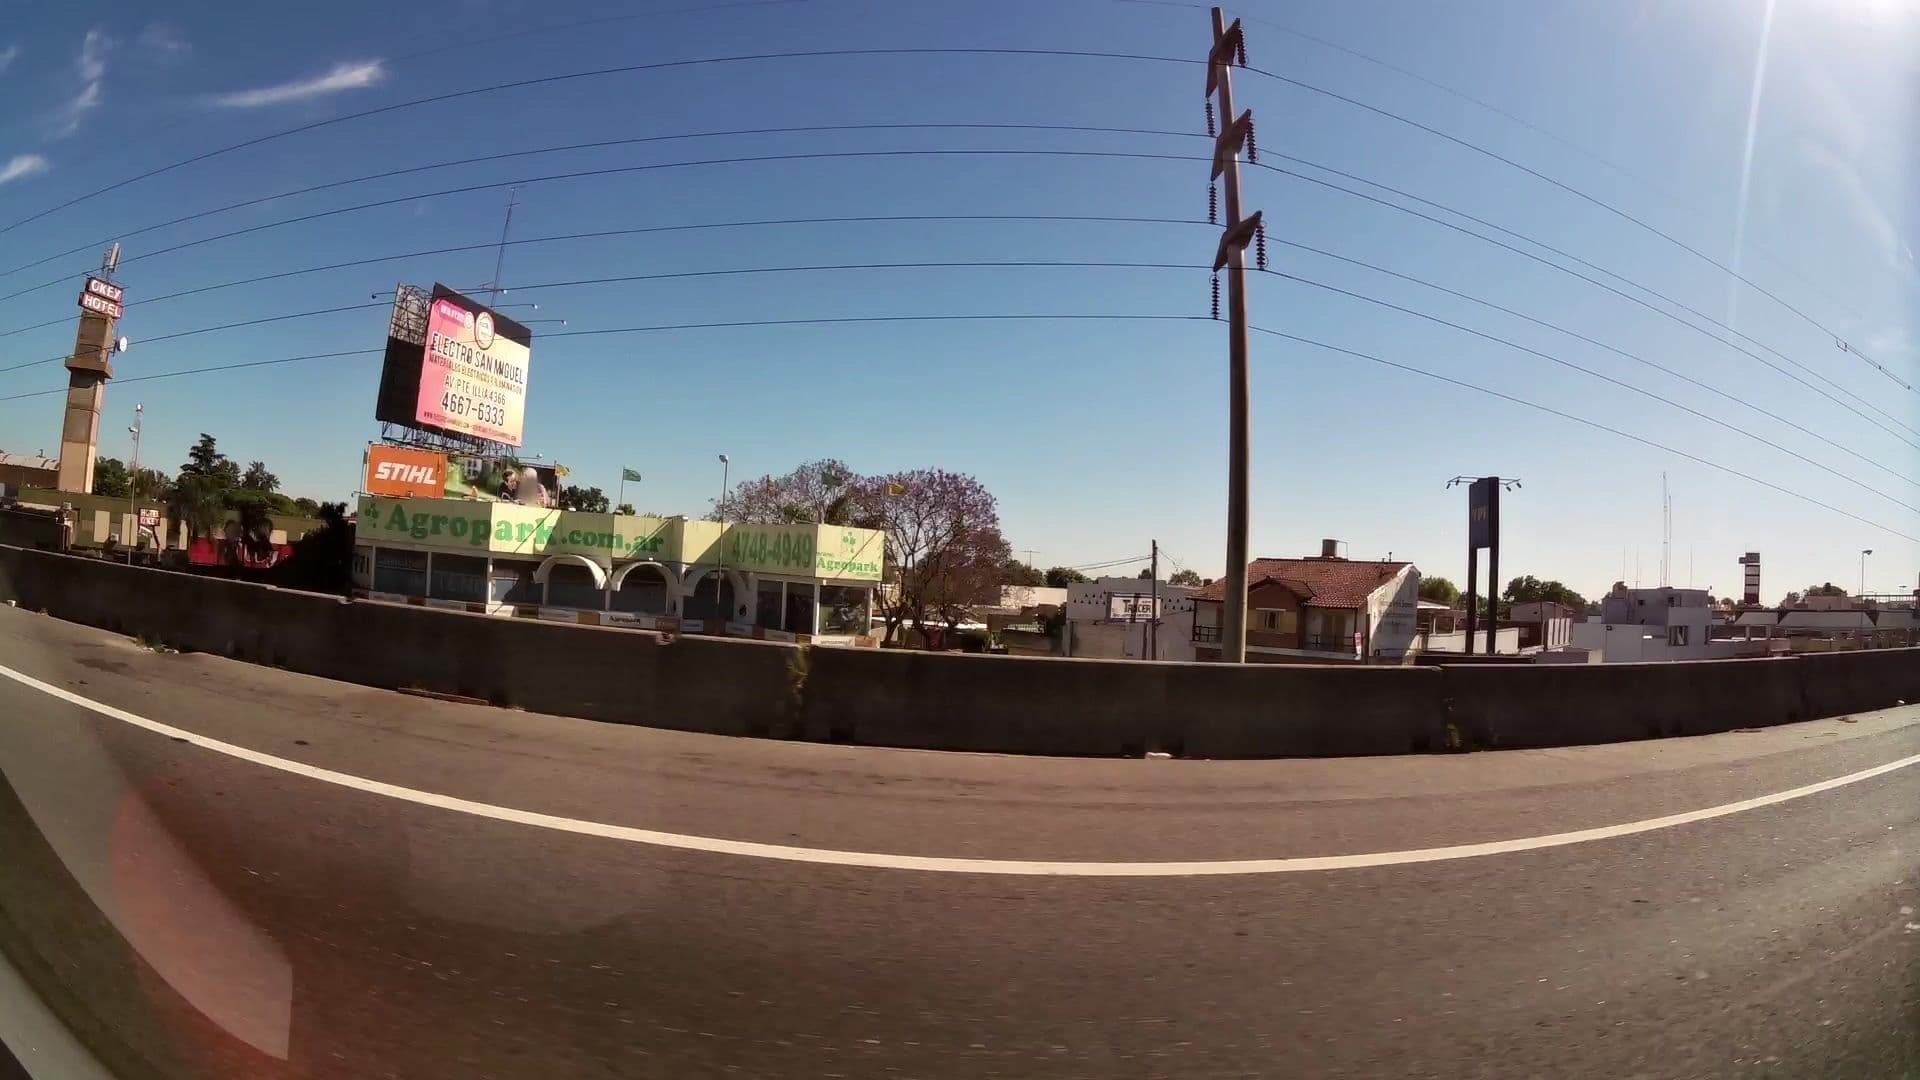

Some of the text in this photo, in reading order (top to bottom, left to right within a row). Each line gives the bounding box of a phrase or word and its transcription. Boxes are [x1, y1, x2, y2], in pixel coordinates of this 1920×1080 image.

[91, 280, 122, 302] OKEY
[84, 294, 120, 317] HOTEL
[431, 332, 523, 384] ELECTRO SAN MIGUEL
[441, 391, 505, 426] 4667-6333
[374, 462, 437, 485] STIHL
[816, 556, 879, 573] Agropark
